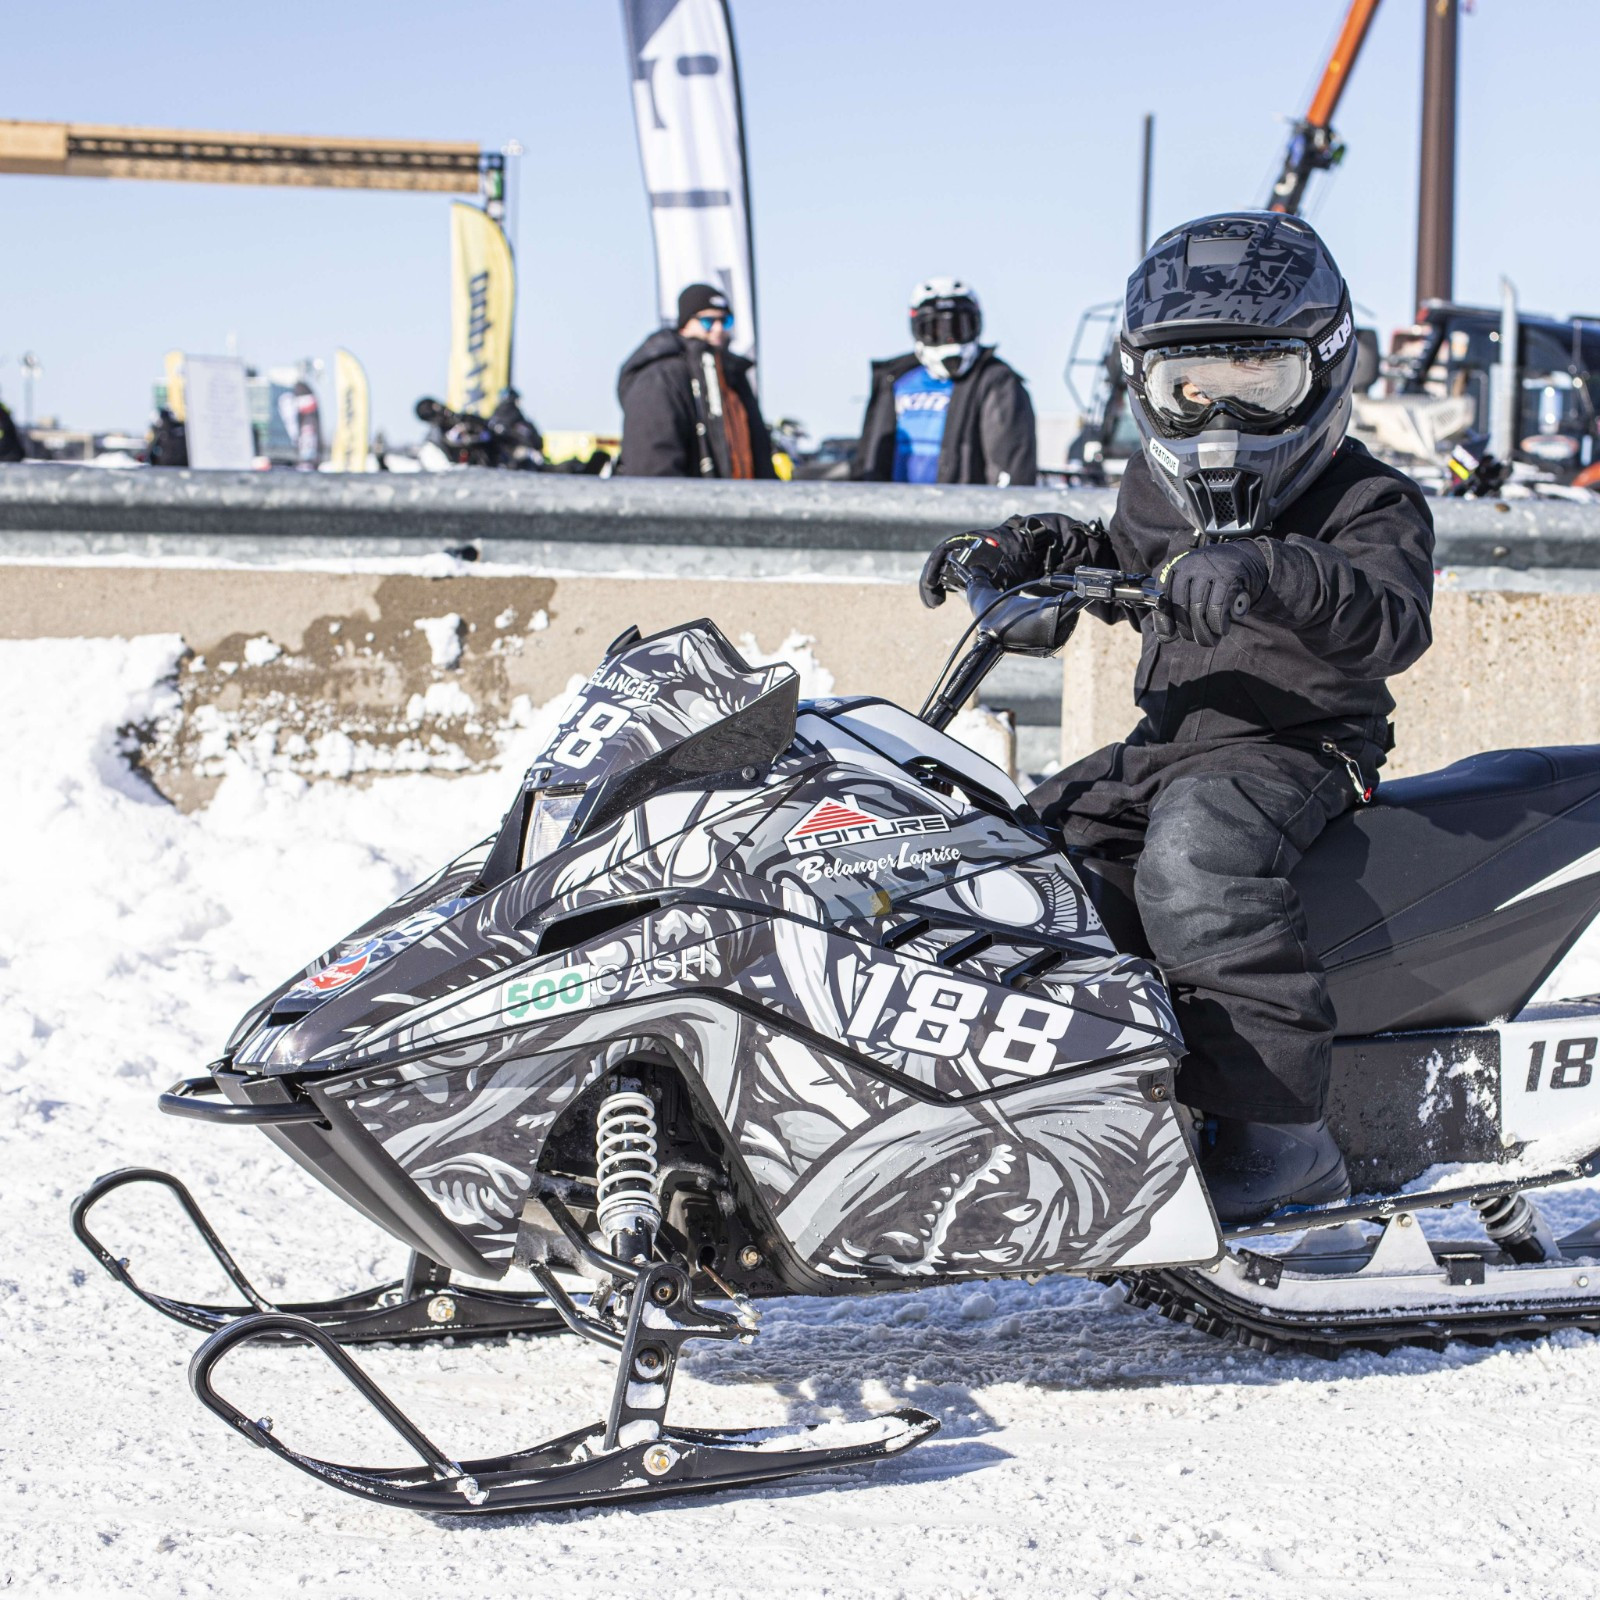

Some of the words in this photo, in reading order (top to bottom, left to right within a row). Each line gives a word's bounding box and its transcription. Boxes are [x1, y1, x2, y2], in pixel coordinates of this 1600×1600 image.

[1318, 312, 1351, 361] 509
[1152, 443, 1177, 471] PRATIQUE
[588, 667, 660, 703] ELANGER
[789, 816, 946, 850] TOITURE
[897, 841, 962, 871] Laprise
[596, 944, 706, 997] CASH
[847, 961, 1075, 1077] 188
[1525, 1036, 1599, 1093] 18
